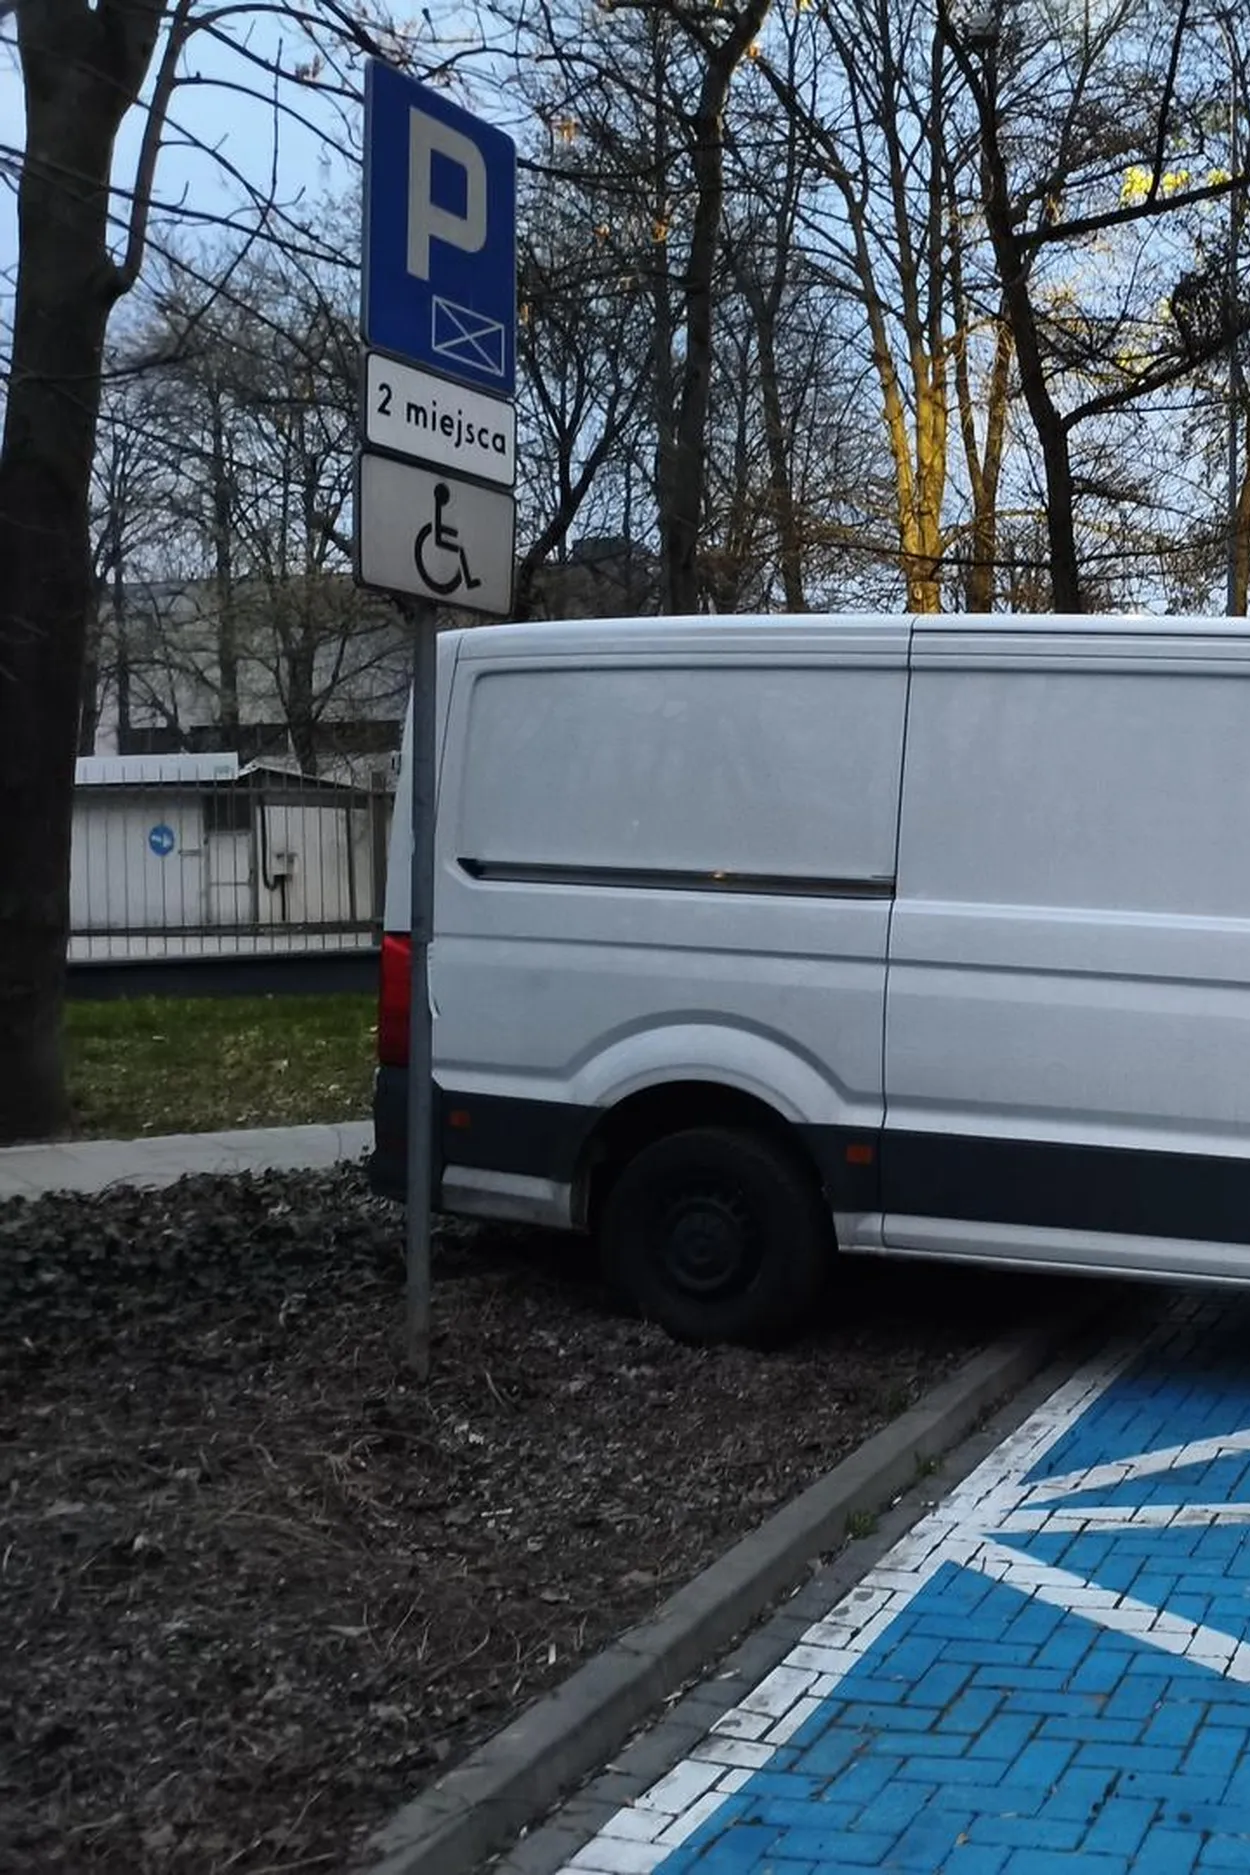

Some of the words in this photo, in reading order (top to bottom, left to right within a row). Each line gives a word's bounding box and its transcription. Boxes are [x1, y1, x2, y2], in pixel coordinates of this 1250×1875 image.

[407, 106, 487, 281] P
[377, 383, 393, 416] 2
[406, 400, 506, 455] miejsca
